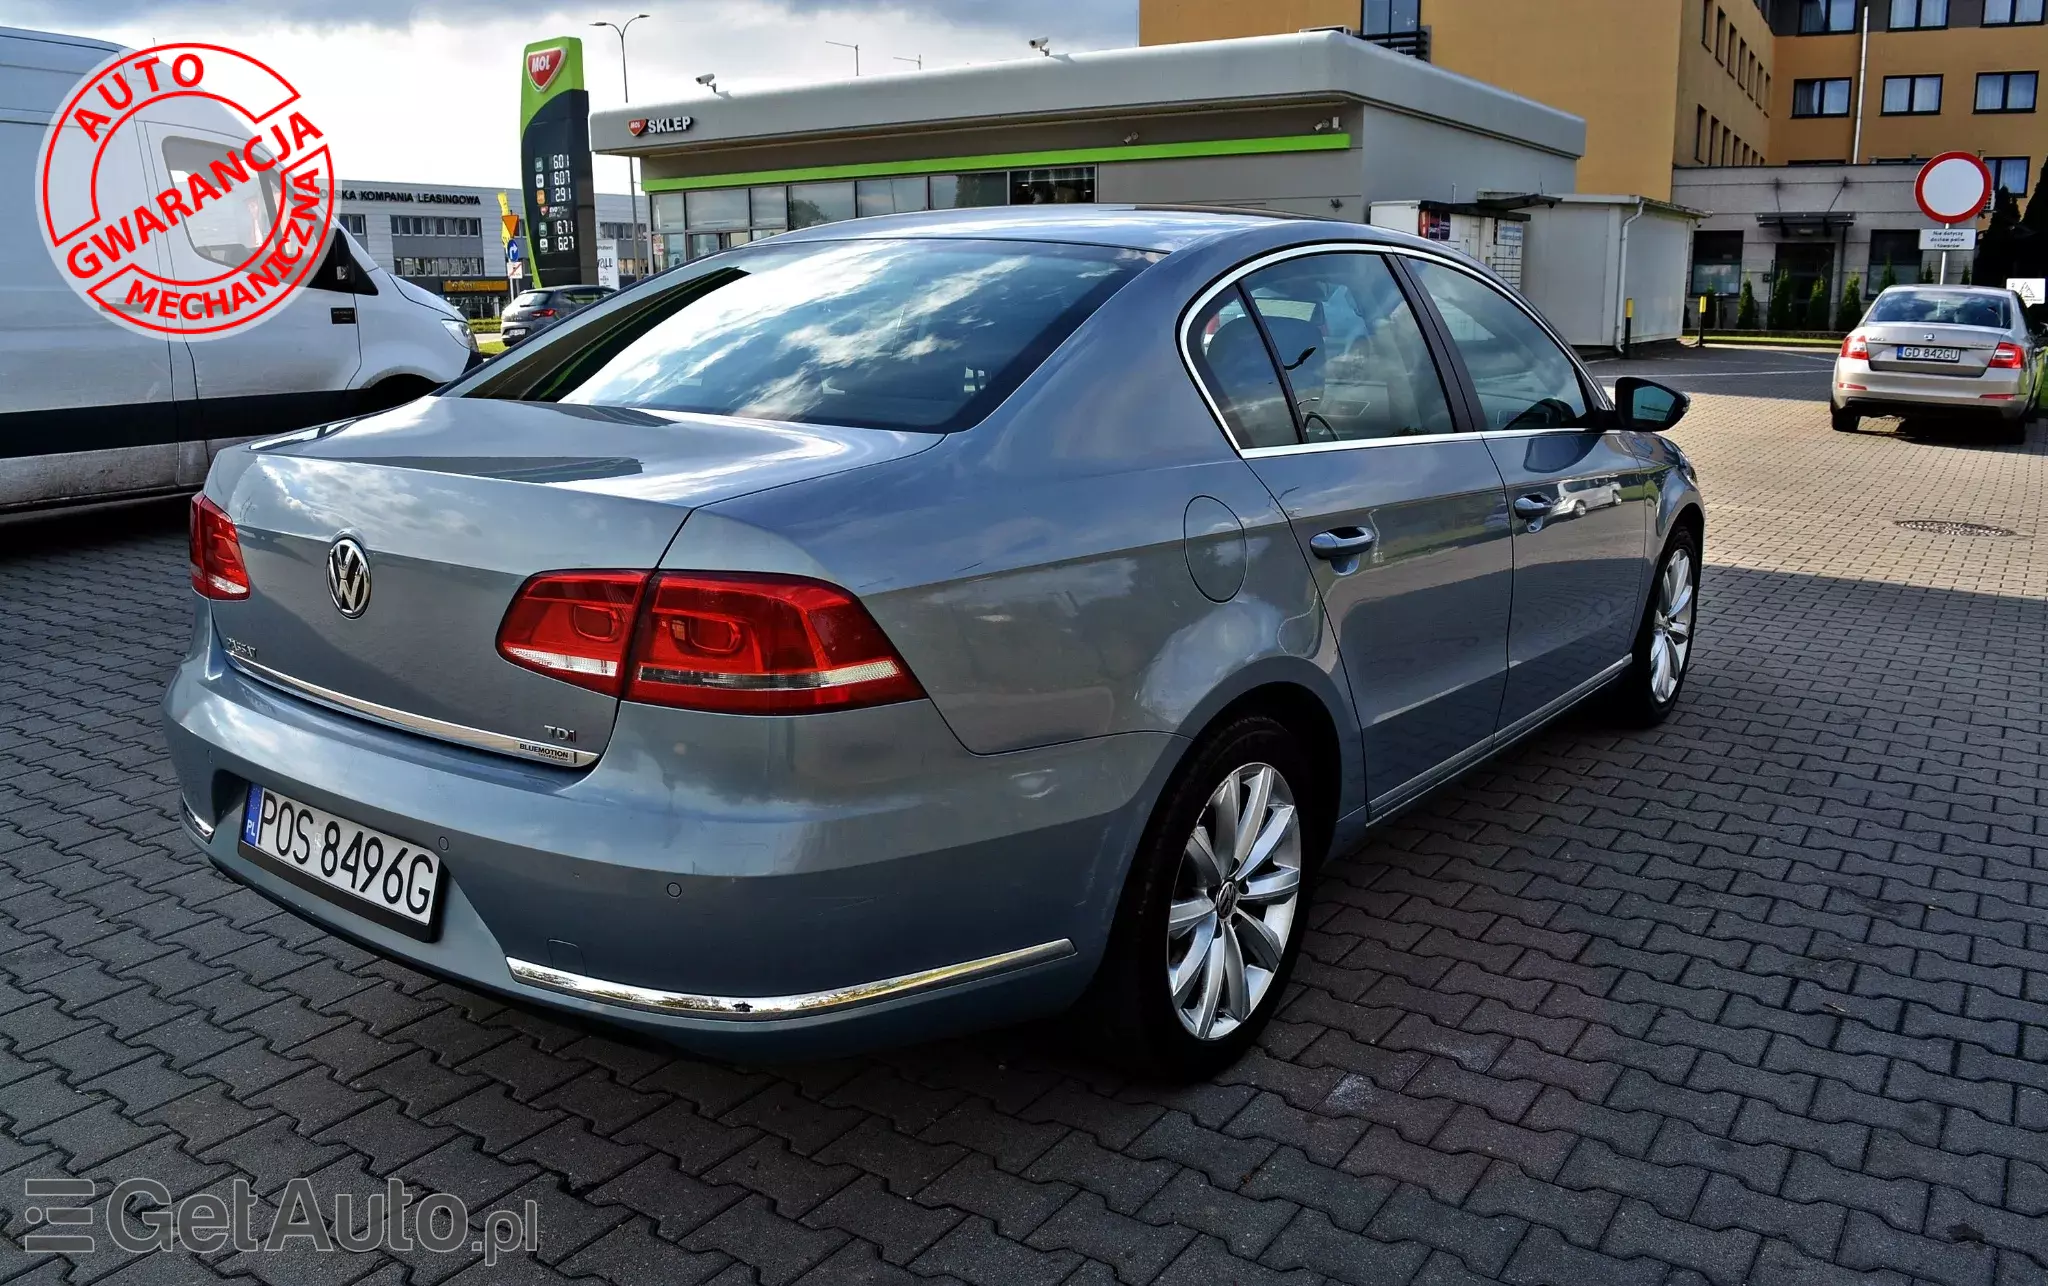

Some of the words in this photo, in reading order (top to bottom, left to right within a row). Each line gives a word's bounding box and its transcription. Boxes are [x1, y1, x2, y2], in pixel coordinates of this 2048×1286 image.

[531, 55, 551, 73] MOL
[648, 116, 691, 133] SKLEP
[360, 191, 414, 202] KOMPANIA
[417, 193, 481, 205] LEASINGOWA
[1904, 347, 1920, 358] GD
[1923, 348, 1958, 360] 842GU
[519, 743, 569, 758] BLUEMOTION
[245, 820, 256, 837] PL
[257, 791, 314, 865] POS
[320, 821, 434, 915] 8496G
